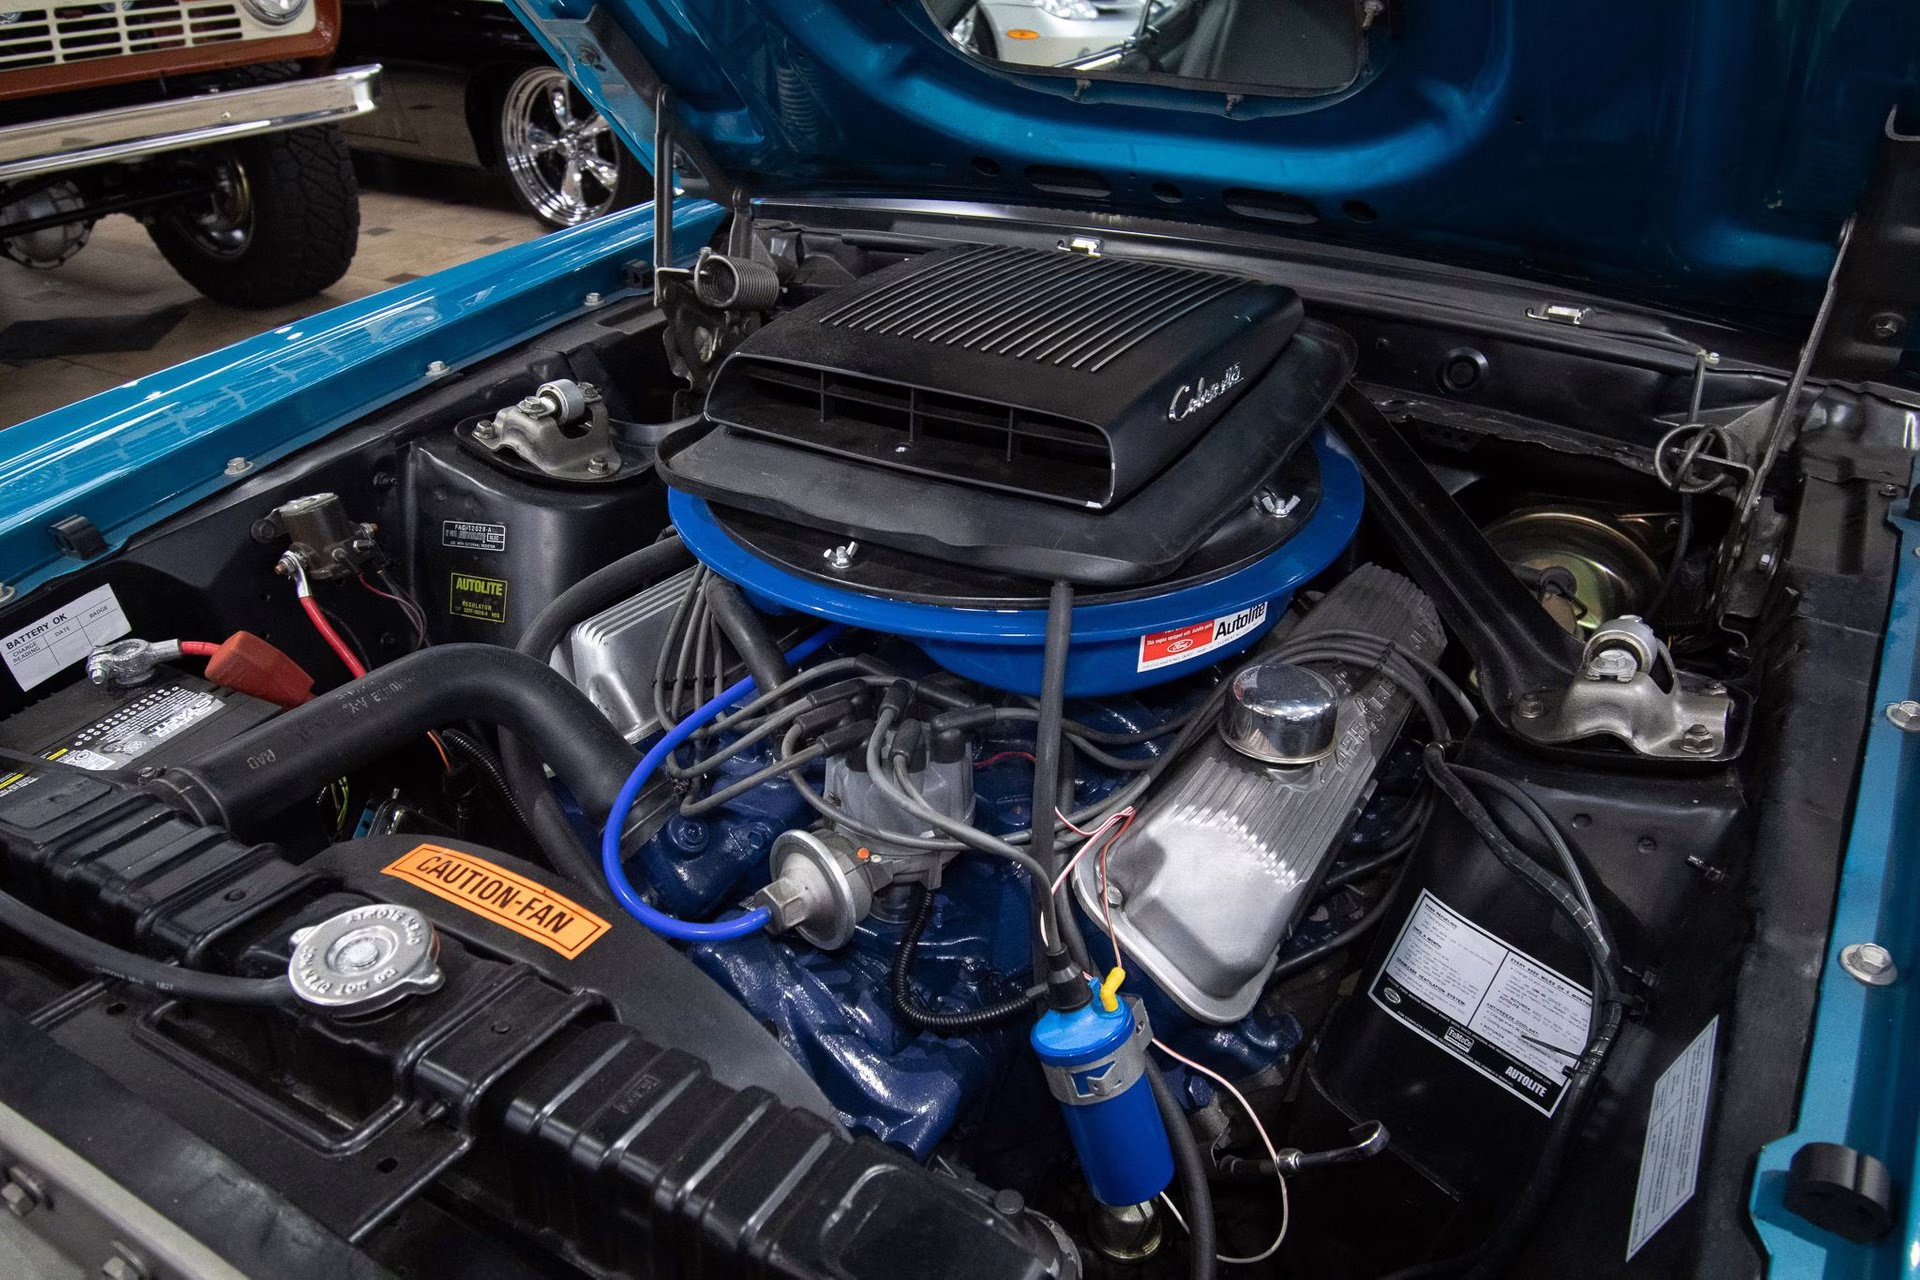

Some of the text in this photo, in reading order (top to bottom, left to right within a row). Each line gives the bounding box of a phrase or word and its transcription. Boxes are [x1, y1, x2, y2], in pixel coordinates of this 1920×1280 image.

[1168, 376, 1220, 421] Cobra
[456, 577, 502, 596] AUTOLITE
[88, 605, 109, 618] BADGE
[462, 600, 492, 611] REGULATOR
[1214, 602, 1266, 640] Autolite
[6, 613, 68, 650] BATTERY OK
[54, 626, 70, 637] DATE
[12, 642, 37, 658] CHARGE
[12, 646, 40, 663] READING
[152, 696, 212, 736] START
[158, 706, 212, 738] SUPER
[246, 750, 276, 770] RAD
[416, 856, 574, 934] CAUTION-FAN
[335, 980, 369, 996] NOT
[1418, 973, 1446, 994] VENTILATION
[1446, 991, 1464, 1005] SYSTEM
[1540, 974, 1555, 986] MILES
[1448, 1028, 1472, 1046] FoMoCo
[1504, 1066, 1548, 1097] AUTOLITE
